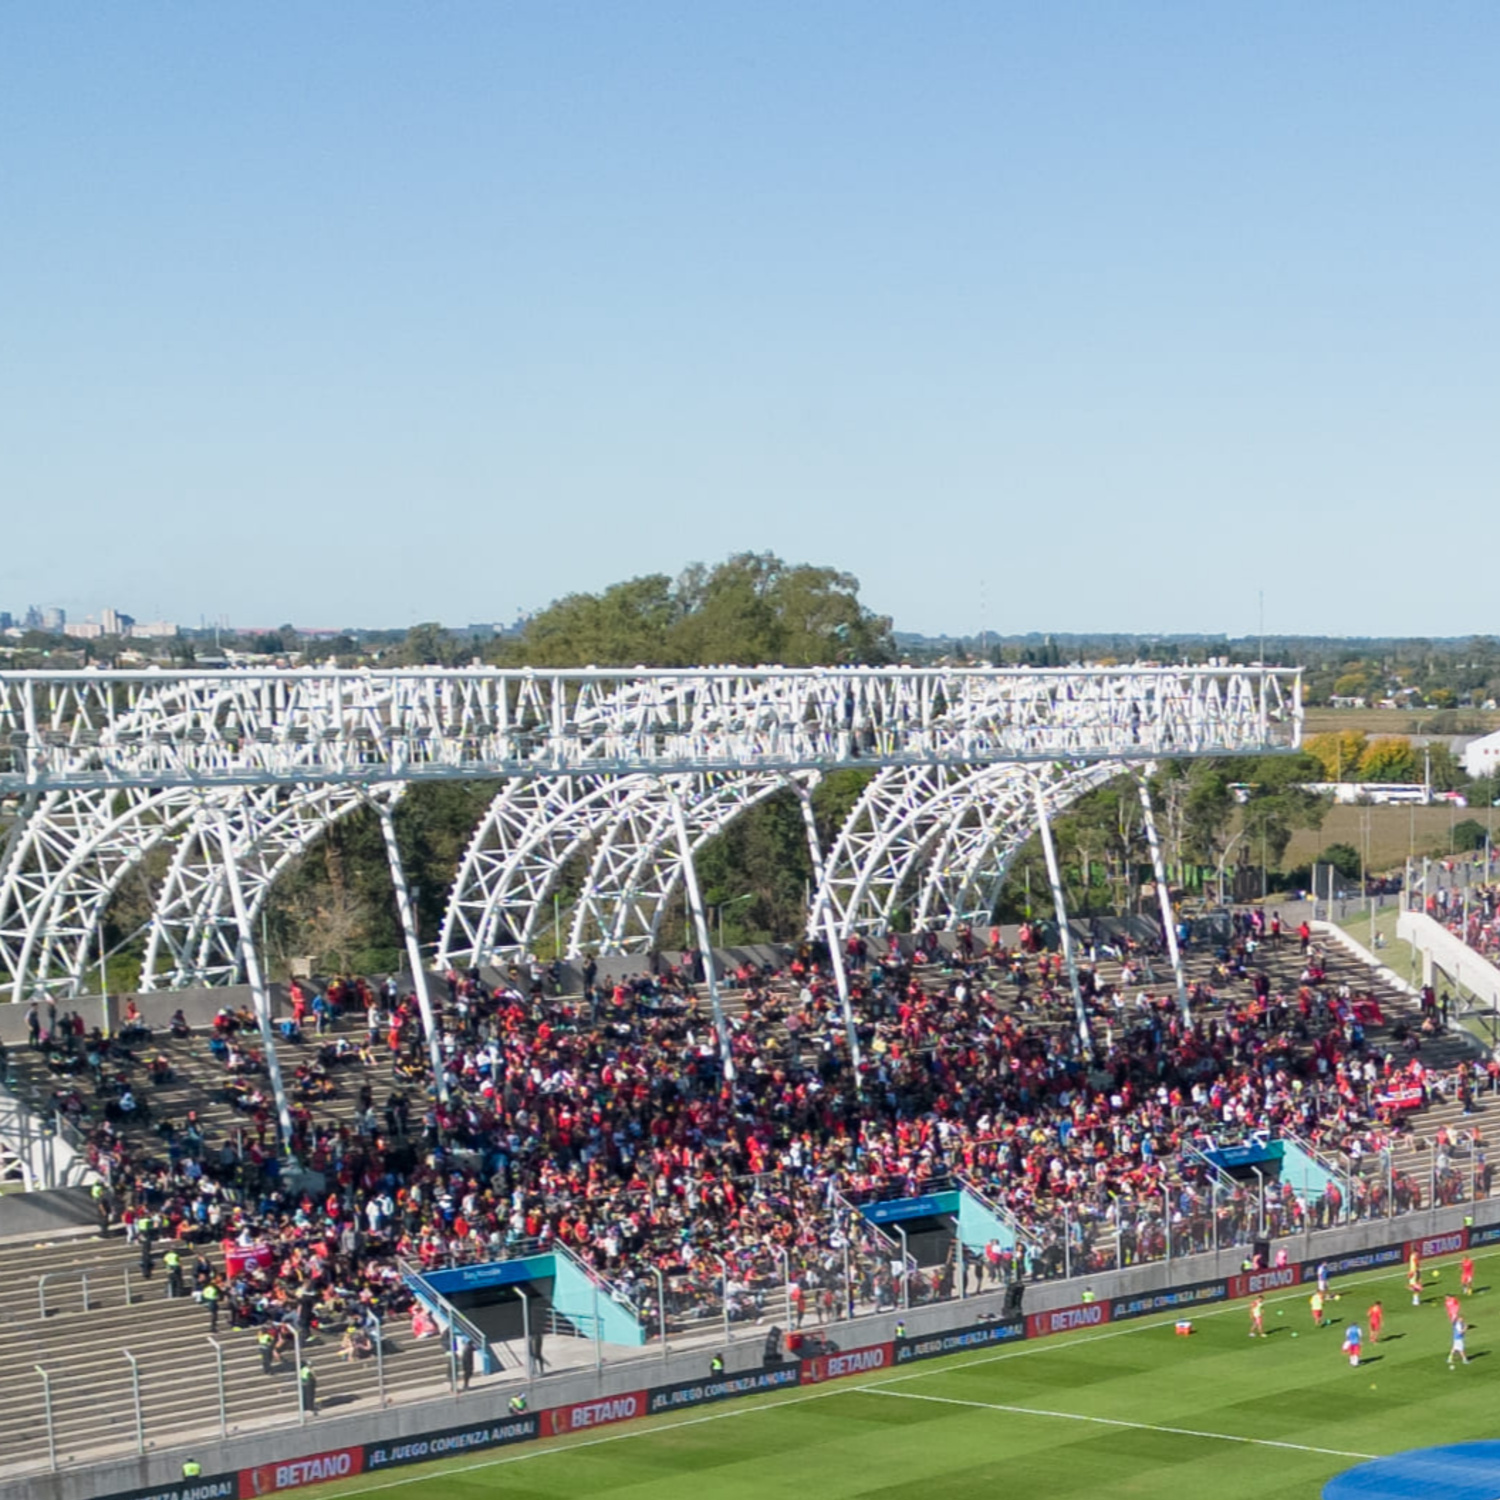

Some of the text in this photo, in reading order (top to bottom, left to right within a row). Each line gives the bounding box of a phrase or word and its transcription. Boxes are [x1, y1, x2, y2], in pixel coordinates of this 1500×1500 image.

[1249, 1269, 1293, 1292] BETANO
[1051, 1305, 1101, 1330] BETANO
[828, 1348, 883, 1377] BETANO
[571, 1396, 637, 1428] BETANO
[276, 1453, 351, 1488] BETANO
